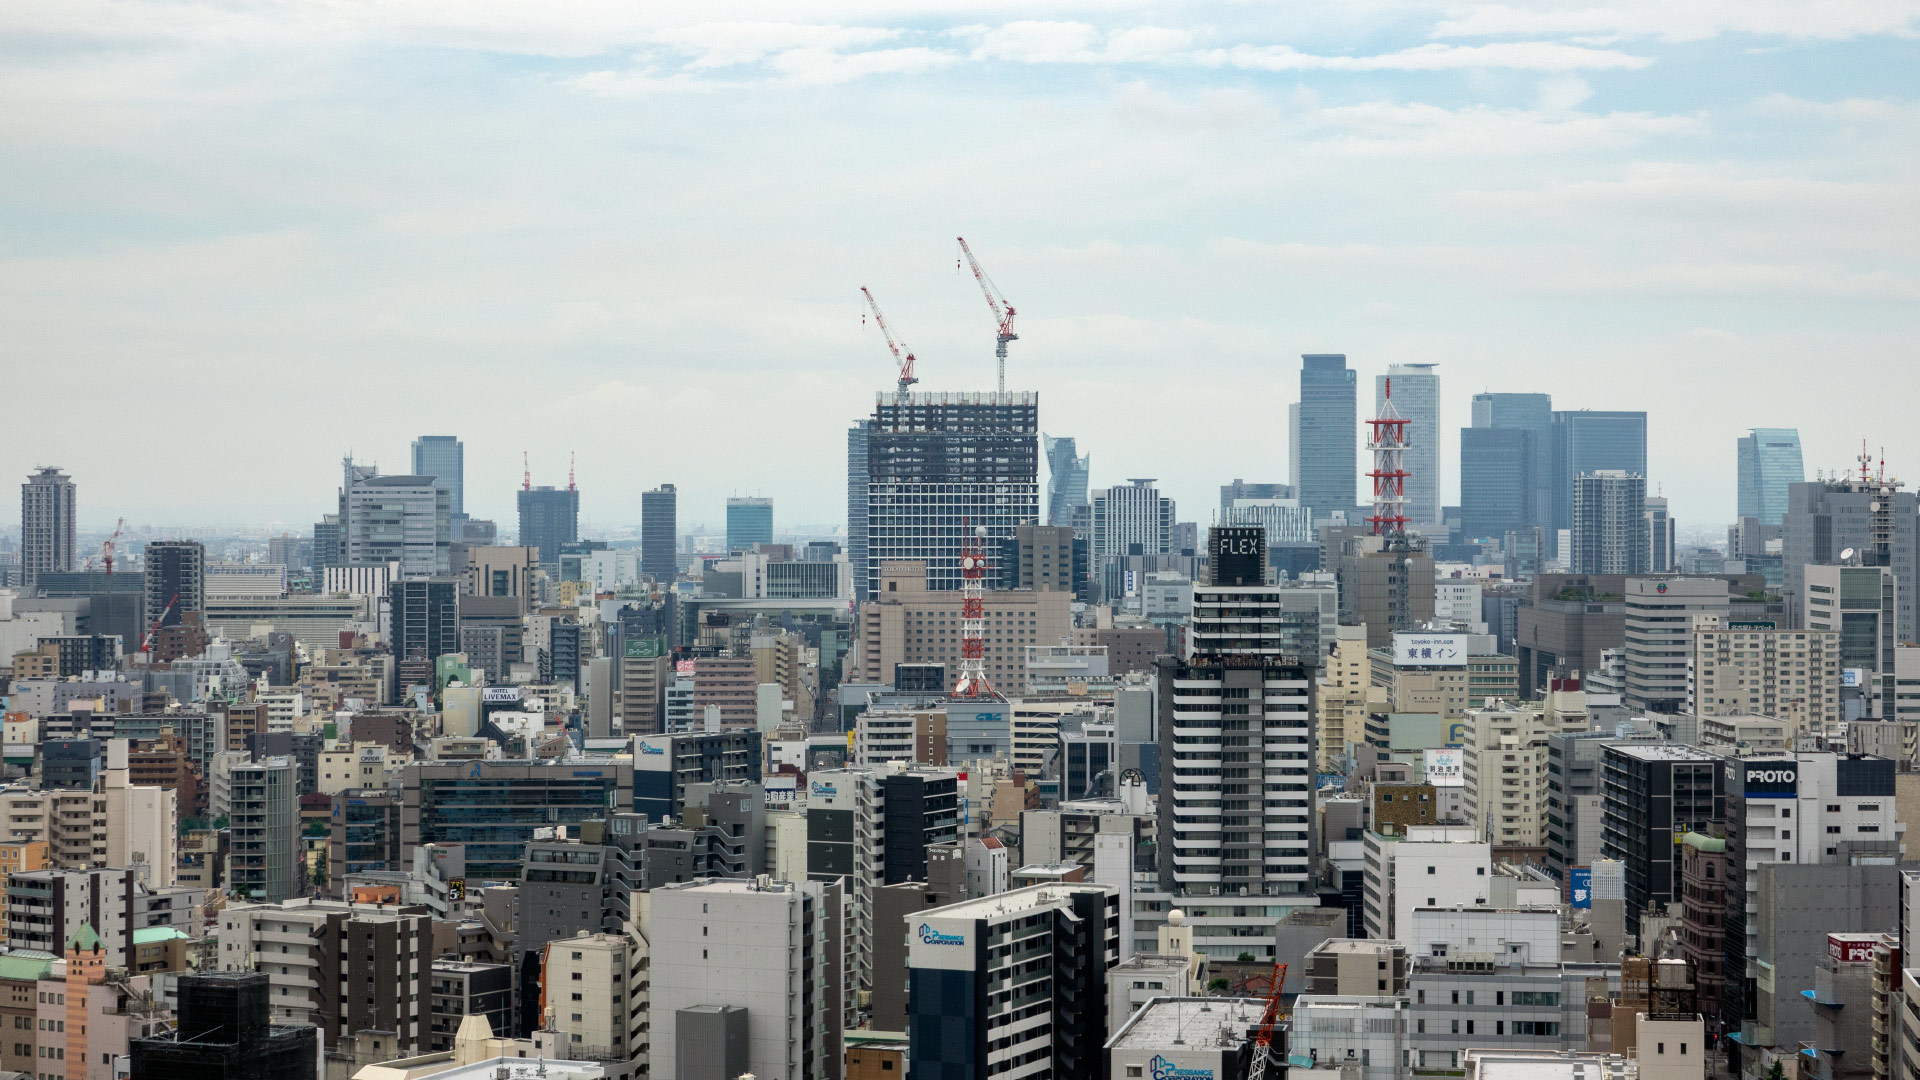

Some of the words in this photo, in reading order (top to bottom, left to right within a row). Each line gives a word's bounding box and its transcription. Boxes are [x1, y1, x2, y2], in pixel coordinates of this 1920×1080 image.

[1221, 539, 1257, 554] FLEX
[205, 565, 276, 577] Matsusakaya
[1408, 648, 1458, 659] 東横イン
[1747, 770, 1795, 783] PROTO
[1575, 889, 1592, 901] 夢
[1165, 1063, 1213, 1076] PRESSANCE
